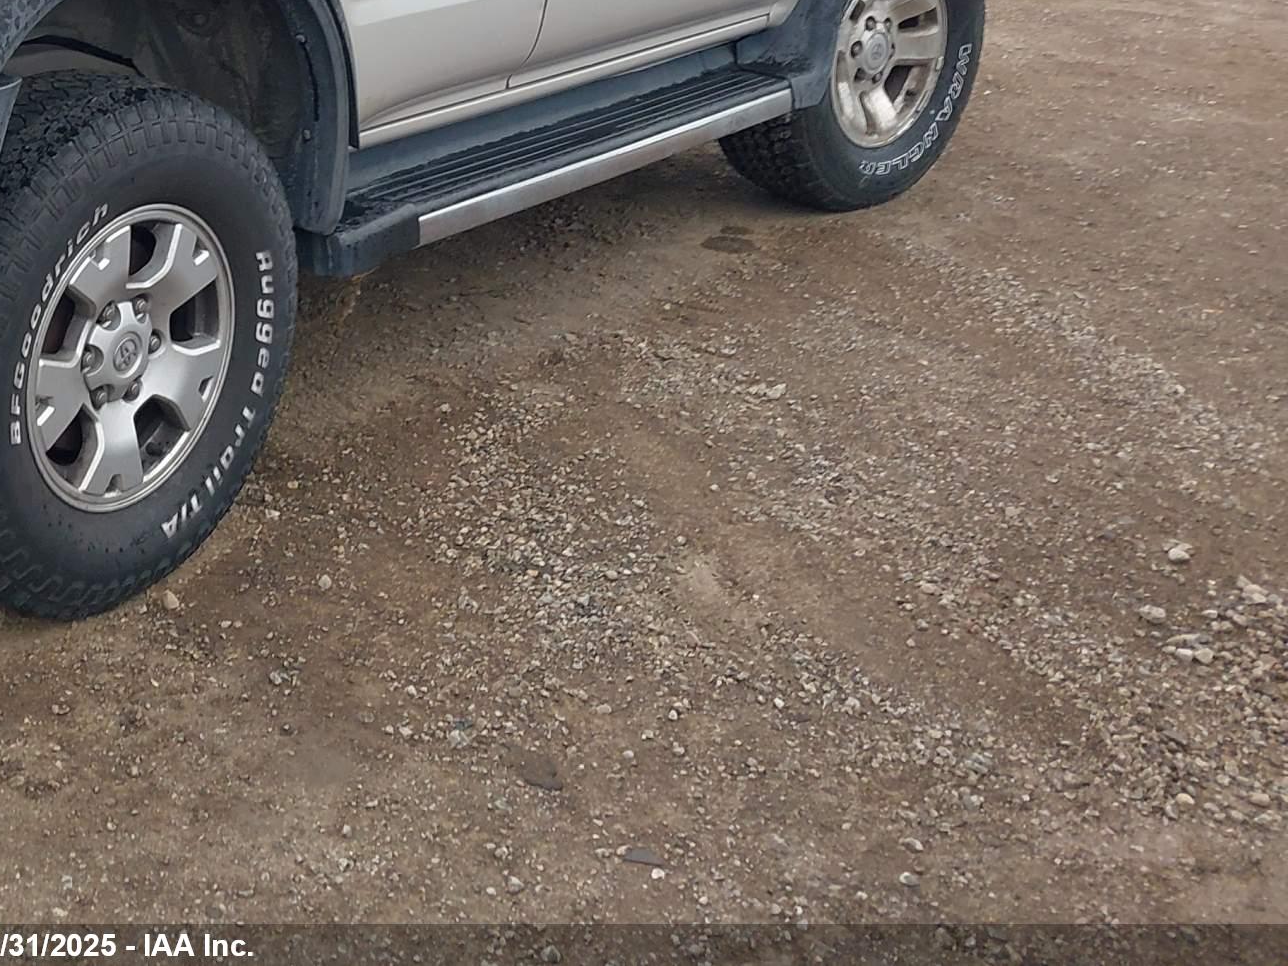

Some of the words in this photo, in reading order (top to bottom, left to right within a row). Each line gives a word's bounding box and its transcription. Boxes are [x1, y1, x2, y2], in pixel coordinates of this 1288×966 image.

[858, 43, 972, 175] WRANGLER
[10, 203, 109, 445] BFGoodrich
[250, 249, 275, 398] Rugged
[160, 493, 203, 539] T/A
[204, 405, 256, 497] Trail
